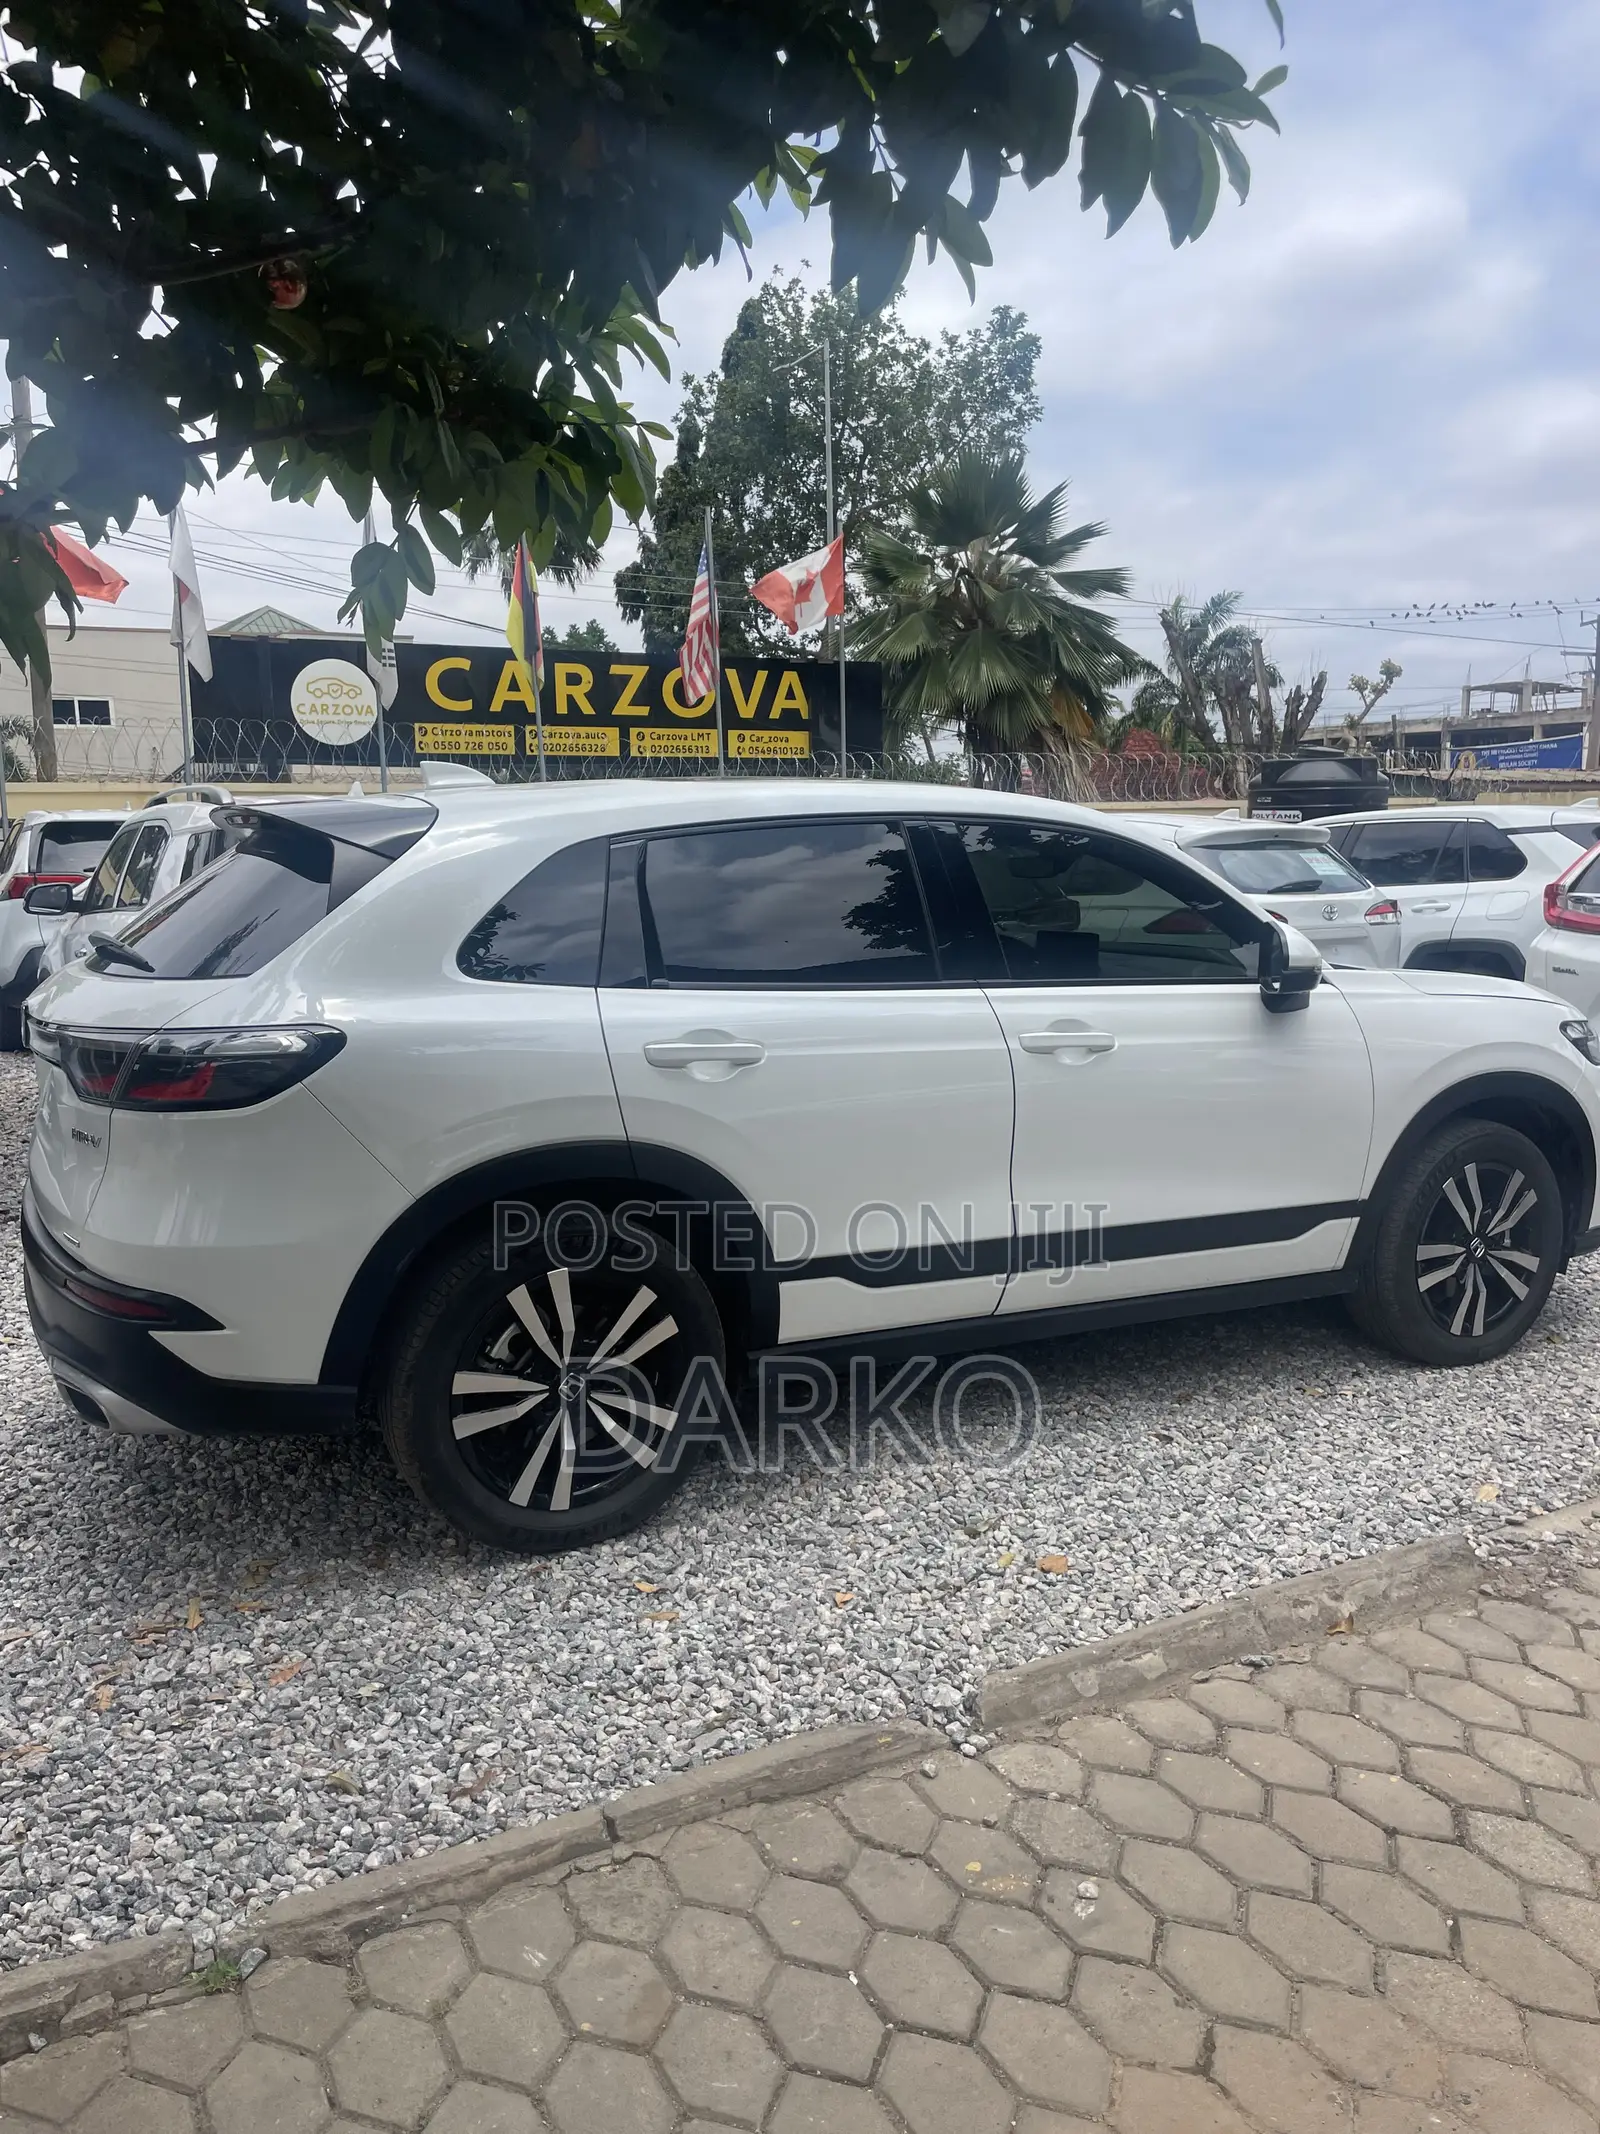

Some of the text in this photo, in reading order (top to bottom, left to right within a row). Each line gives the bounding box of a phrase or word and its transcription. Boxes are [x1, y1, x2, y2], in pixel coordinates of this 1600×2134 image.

[425, 657, 809, 720] CARZOVA
[296, 703, 375, 717] CARZOVA
[649, 731, 712, 742] Carzova LMT
[749, 733, 790, 744] Car_zova
[433, 740, 508, 751] 0550 726 050
[650, 744, 711, 754] 0202656313
[748, 746, 805, 756] 0549610128
